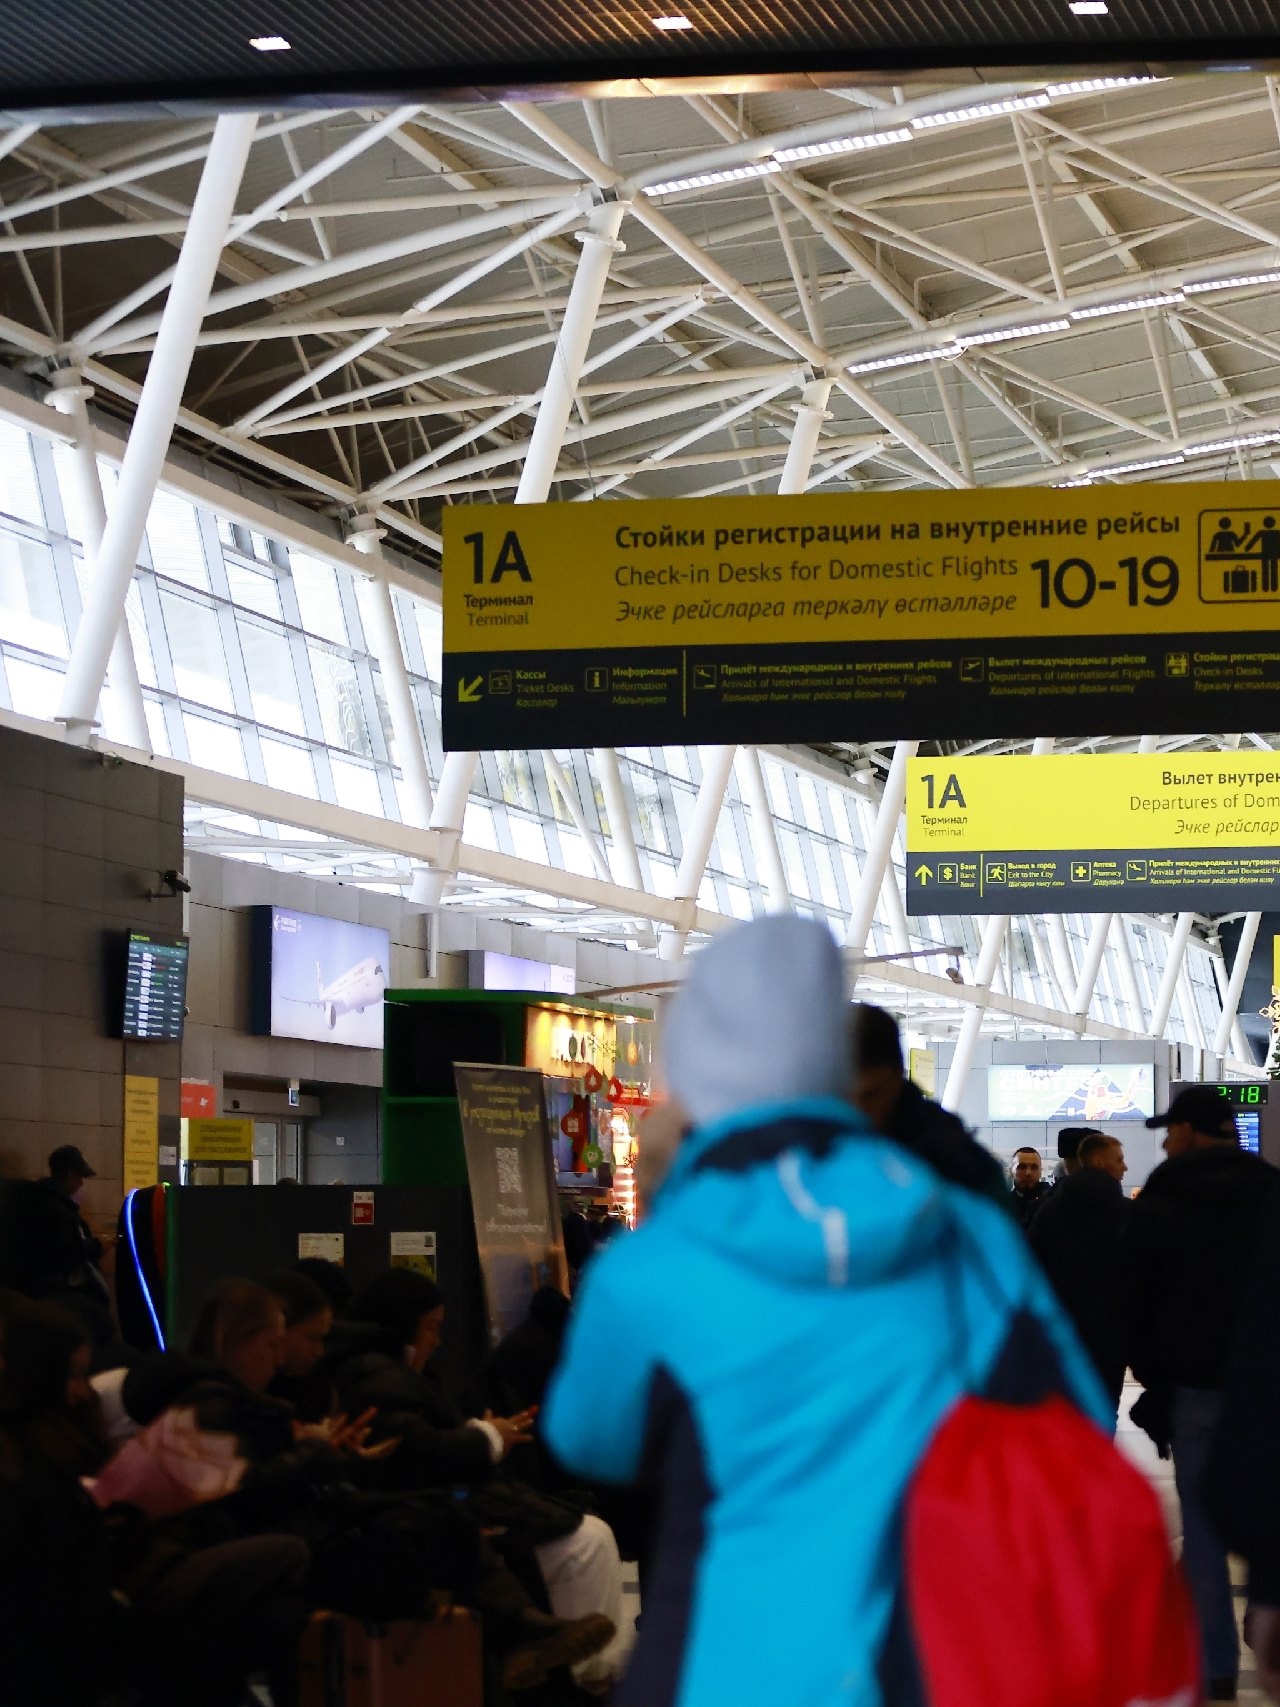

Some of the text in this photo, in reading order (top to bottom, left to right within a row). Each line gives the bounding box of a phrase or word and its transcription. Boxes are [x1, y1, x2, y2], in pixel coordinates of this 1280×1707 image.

[615, 511, 1180, 551] Стойки регистрации на внутренние рейсы
[463, 530, 533, 585] 1A
[615, 555, 1018, 586] Check-in Desks for Domestic Flights
[1030, 556, 1180, 608] 10-19
[464, 593, 534, 608] Терминал
[615, 601, 667, 622] Эчке
[673, 598, 786, 624] рейсларга
[467, 612, 529, 627] Terminal
[988, 656, 1021, 667] Вылет
[1110, 655, 1147, 665] рейсов
[1193, 652, 1229, 663] Стойки
[515, 670, 547, 680] Кассы
[612, 667, 678, 679] Информация
[988, 669, 1156, 682] Departures of International Flights
[1236, 666, 1264, 677] Desks
[612, 681, 668, 692] Information
[720, 673, 937, 689] Arrivals of International and Domestic Flights
[515, 683, 575, 694] Ticket Desks
[1162, 771, 1214, 786] Вылет
[921, 774, 967, 809] 1A
[1130, 796, 1218, 813] Departures
[1223, 793, 1240, 809] of
[921, 815, 967, 826] Терминал
[923, 827, 965, 837] Terminal
[1174, 819, 1211, 834] Эчке
[1216, 818, 1280, 836] рейслар
[960, 863, 977, 871] Банк
[1093, 869, 1122, 877] Pharmacy
[1241, 867, 1272, 875] Domestic
[1008, 871, 1020, 879] Exit
